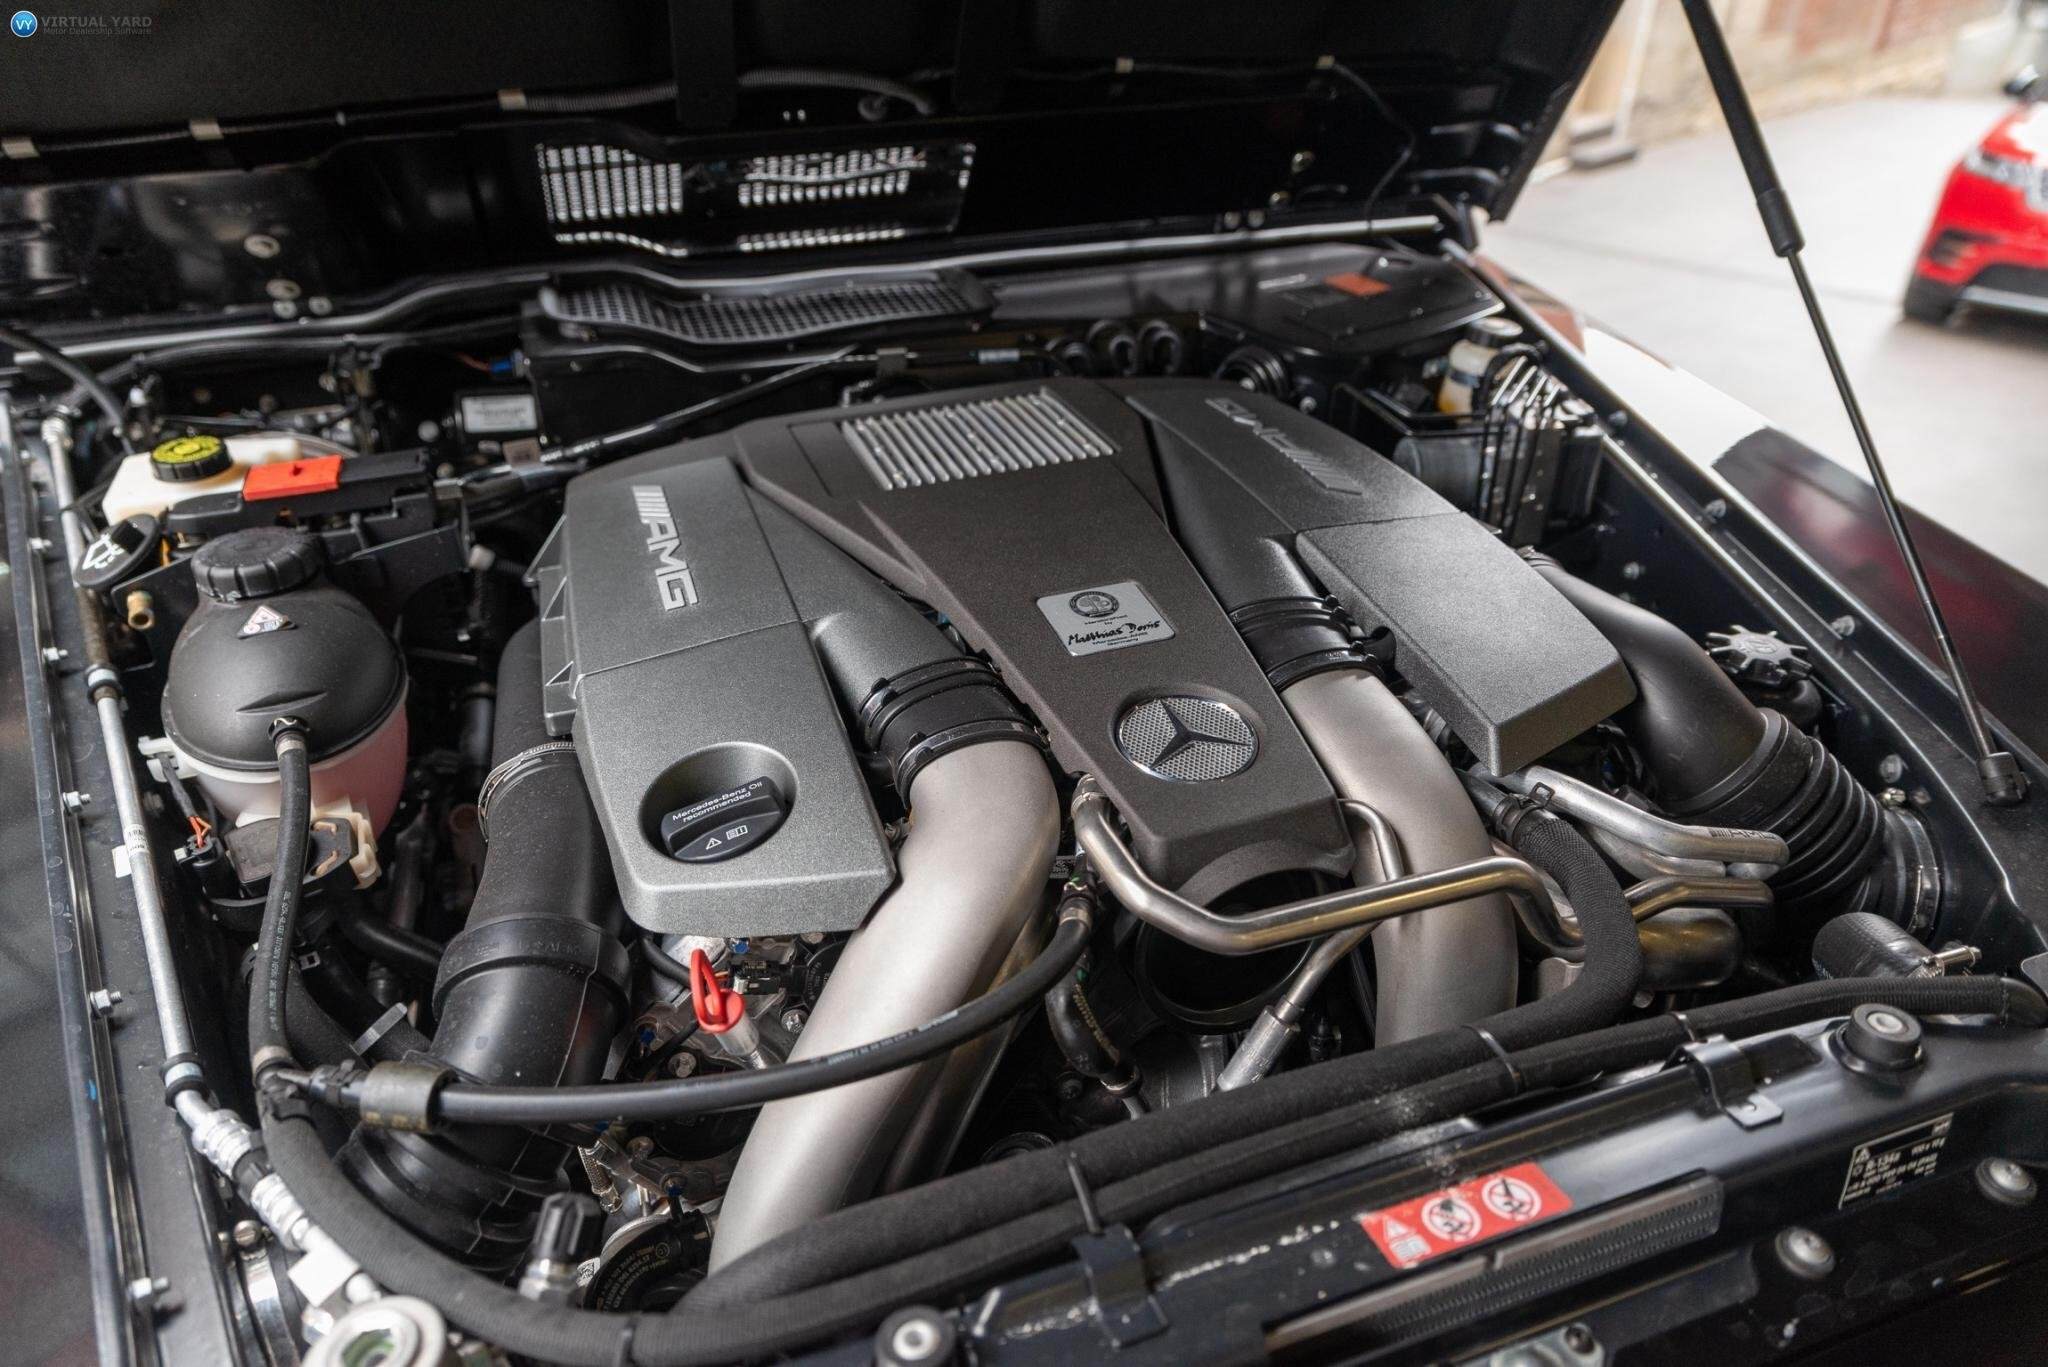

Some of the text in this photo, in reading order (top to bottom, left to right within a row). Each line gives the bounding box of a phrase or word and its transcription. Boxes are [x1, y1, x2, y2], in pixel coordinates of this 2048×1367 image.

[640, 513, 699, 612] AMG
[672, 781, 763, 821] Mercedes-Benz Oil
[683, 791, 752, 823] recommended
